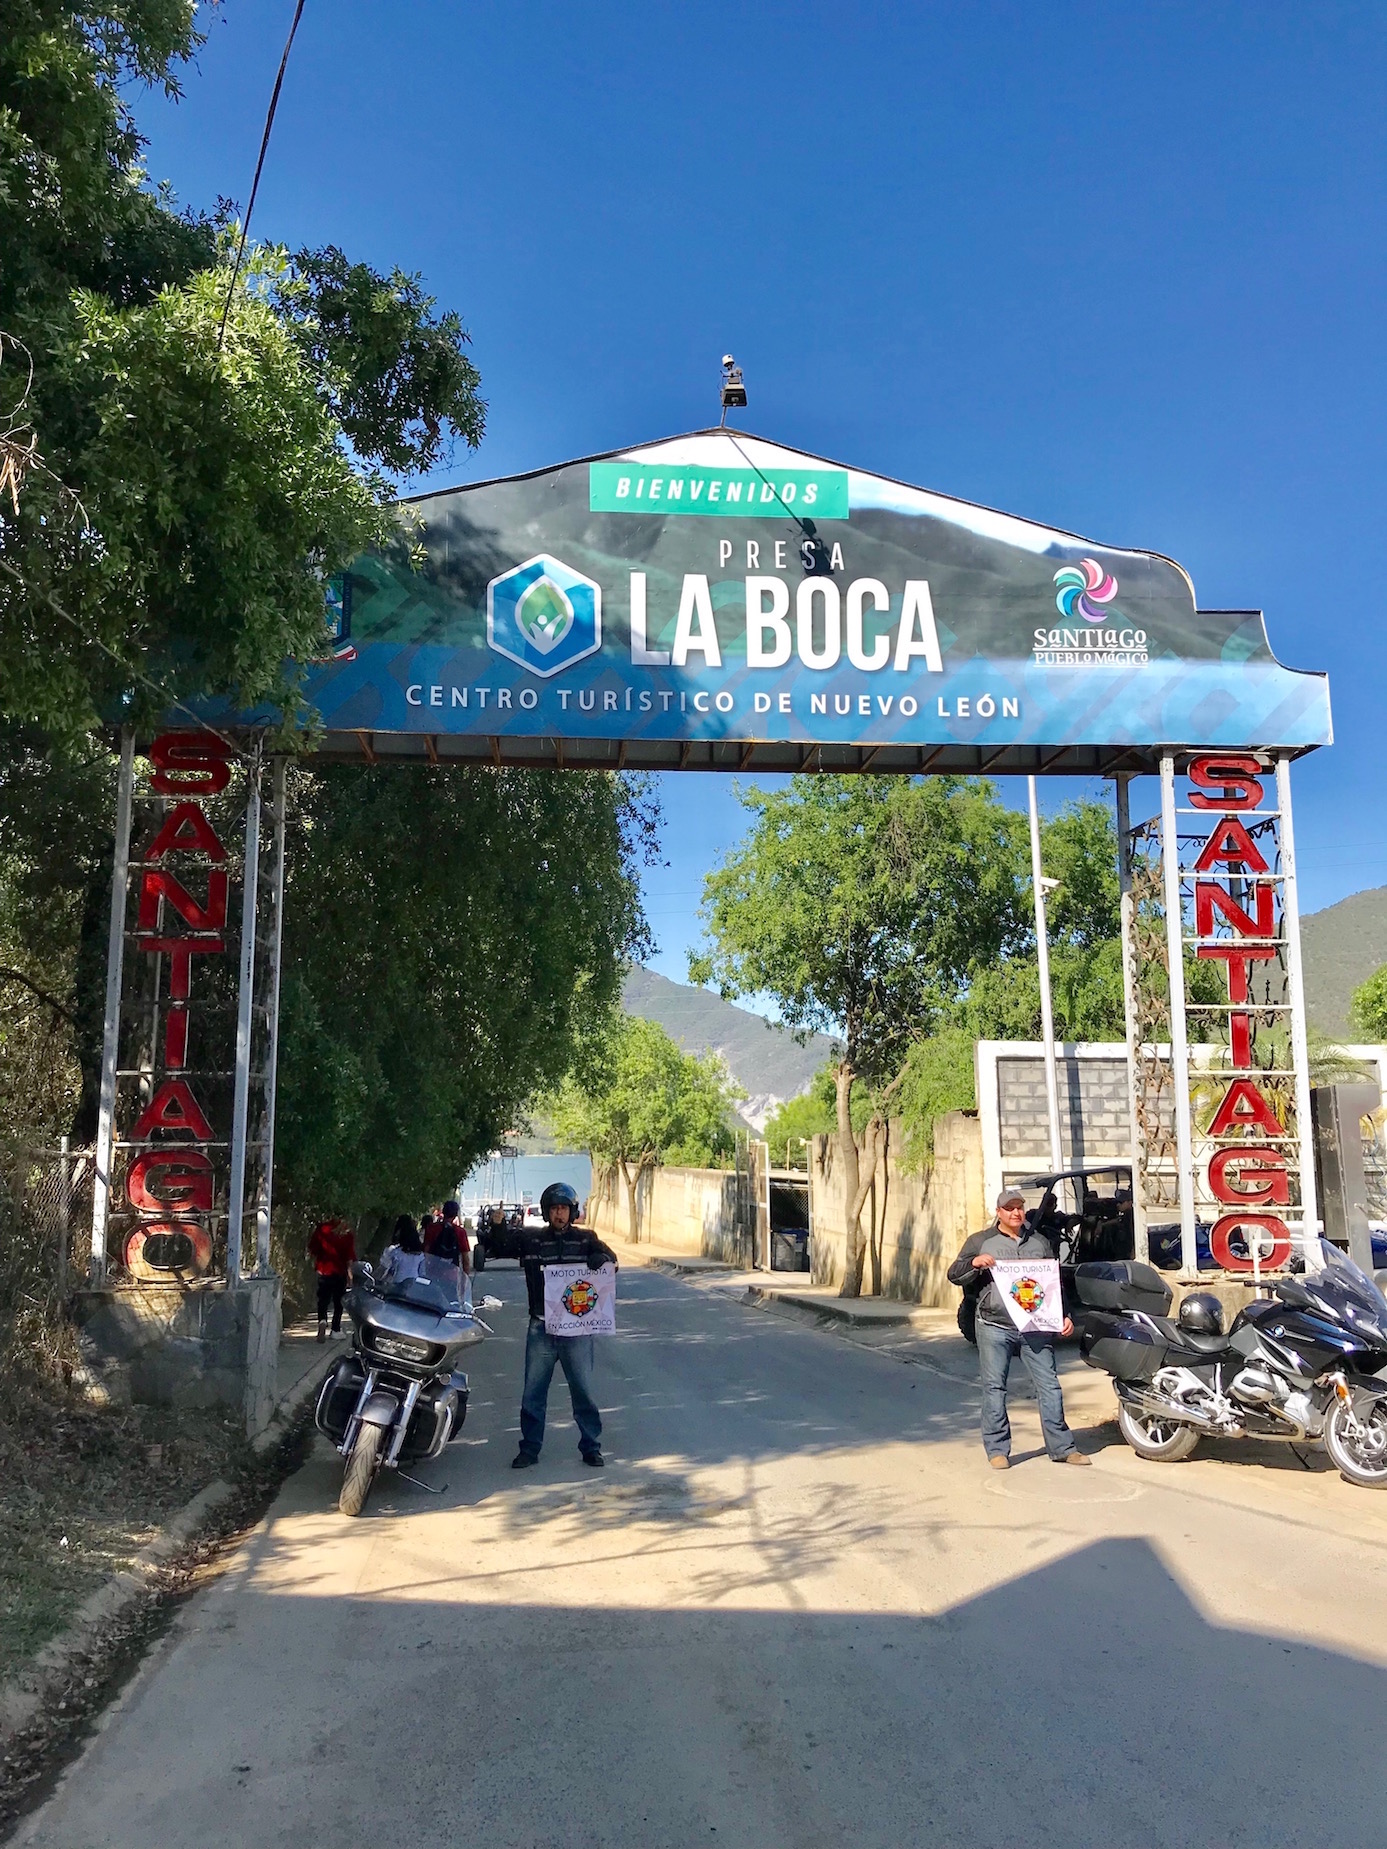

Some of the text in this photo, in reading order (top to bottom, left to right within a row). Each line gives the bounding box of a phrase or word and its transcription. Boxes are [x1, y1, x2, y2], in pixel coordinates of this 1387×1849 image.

[615, 477, 818, 504] BIENVENIDOS
[719, 539, 845, 571] PRESA
[631, 572, 943, 672] LA BOCA
[405, 685, 1019, 718] CENTRO TURÍSTICO DE NUEVO LEÓN
[120, 731, 232, 1284] SANTIAGO
[1186, 754, 1292, 1273] SANTIAGO
[550, 1270, 576, 1278] MOTO
[996, 1265, 1052, 1274] MOTO TURISTA
[559, 1320, 586, 1330] ACCIÓN
